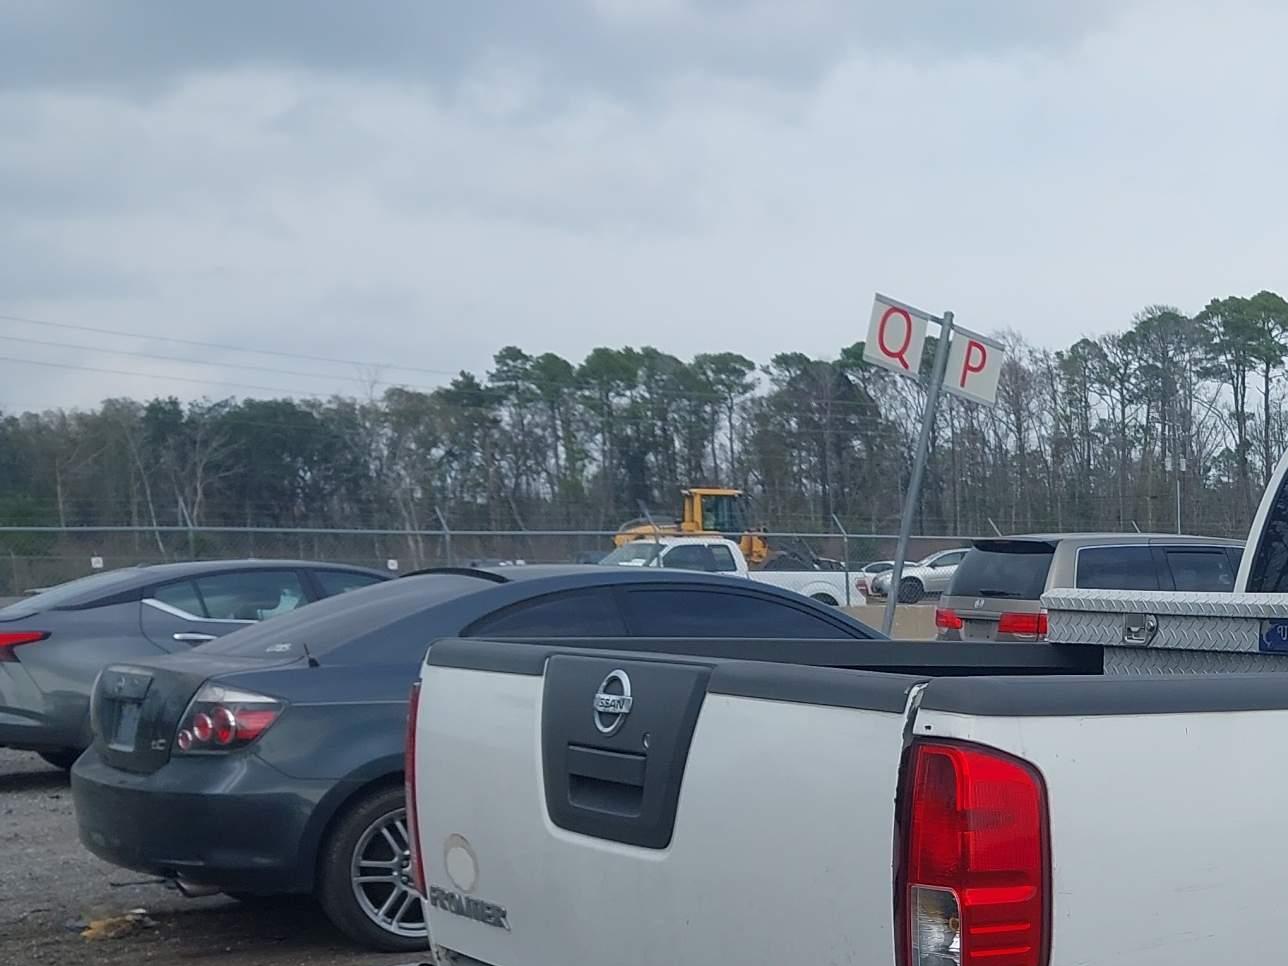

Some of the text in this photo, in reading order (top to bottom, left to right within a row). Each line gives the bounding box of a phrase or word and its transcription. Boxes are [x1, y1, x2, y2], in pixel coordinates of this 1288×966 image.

[878, 306, 912, 370] Q
[960, 340, 987, 388] P
[595, 695, 625, 711] SSAN
